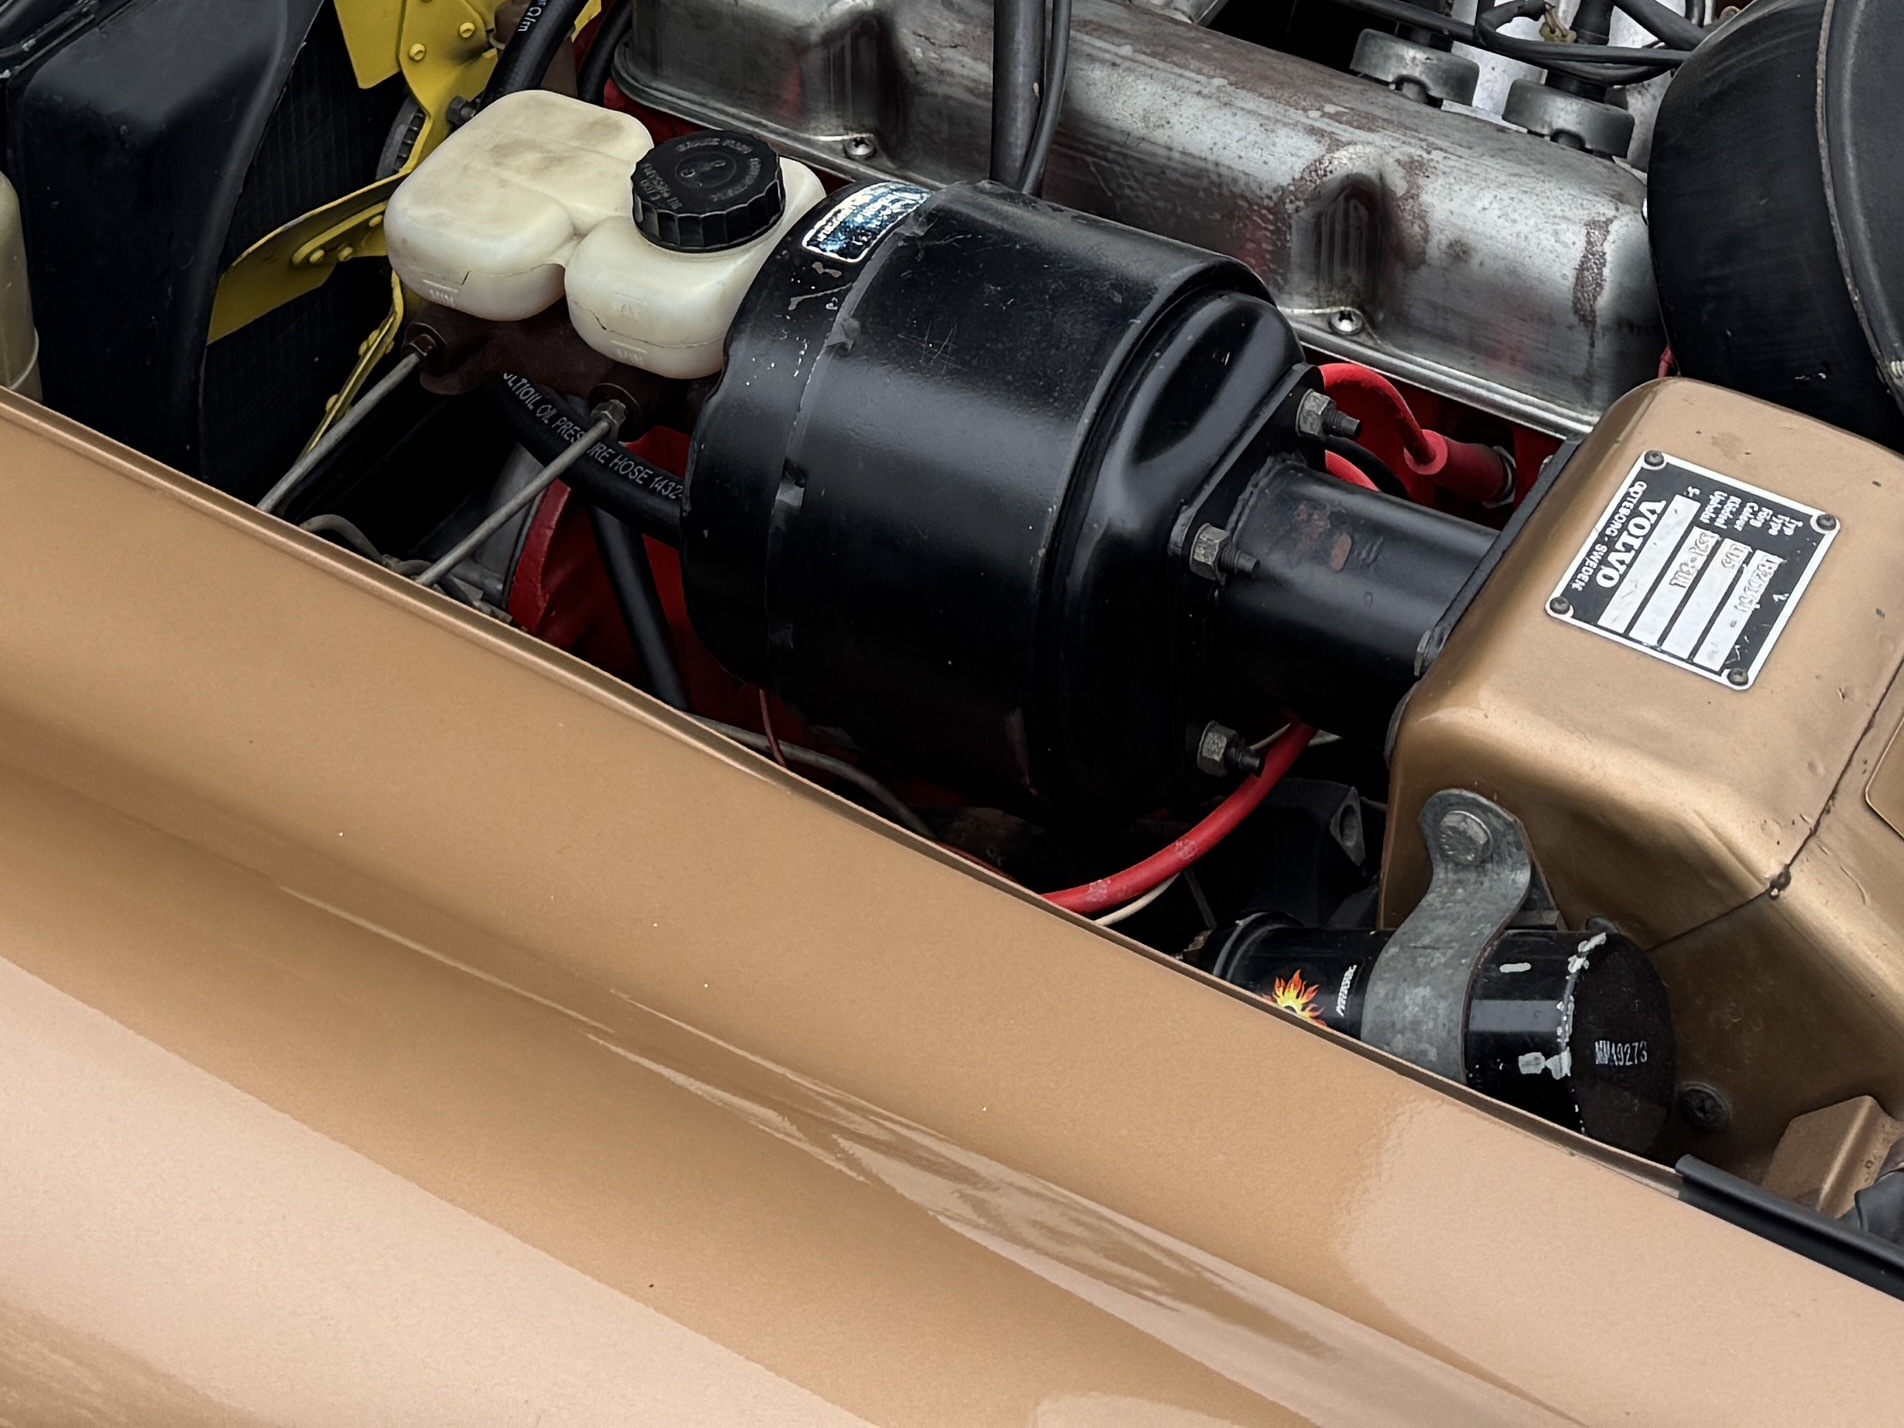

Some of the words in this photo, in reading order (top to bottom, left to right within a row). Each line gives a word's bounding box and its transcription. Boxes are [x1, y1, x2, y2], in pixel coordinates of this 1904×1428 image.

[536, 403, 559, 425] OIL
[608, 454, 654, 486] HOSE
[1570, 543, 1608, 592] SWEDEN
[1596, 499, 1667, 588] VOLVO
